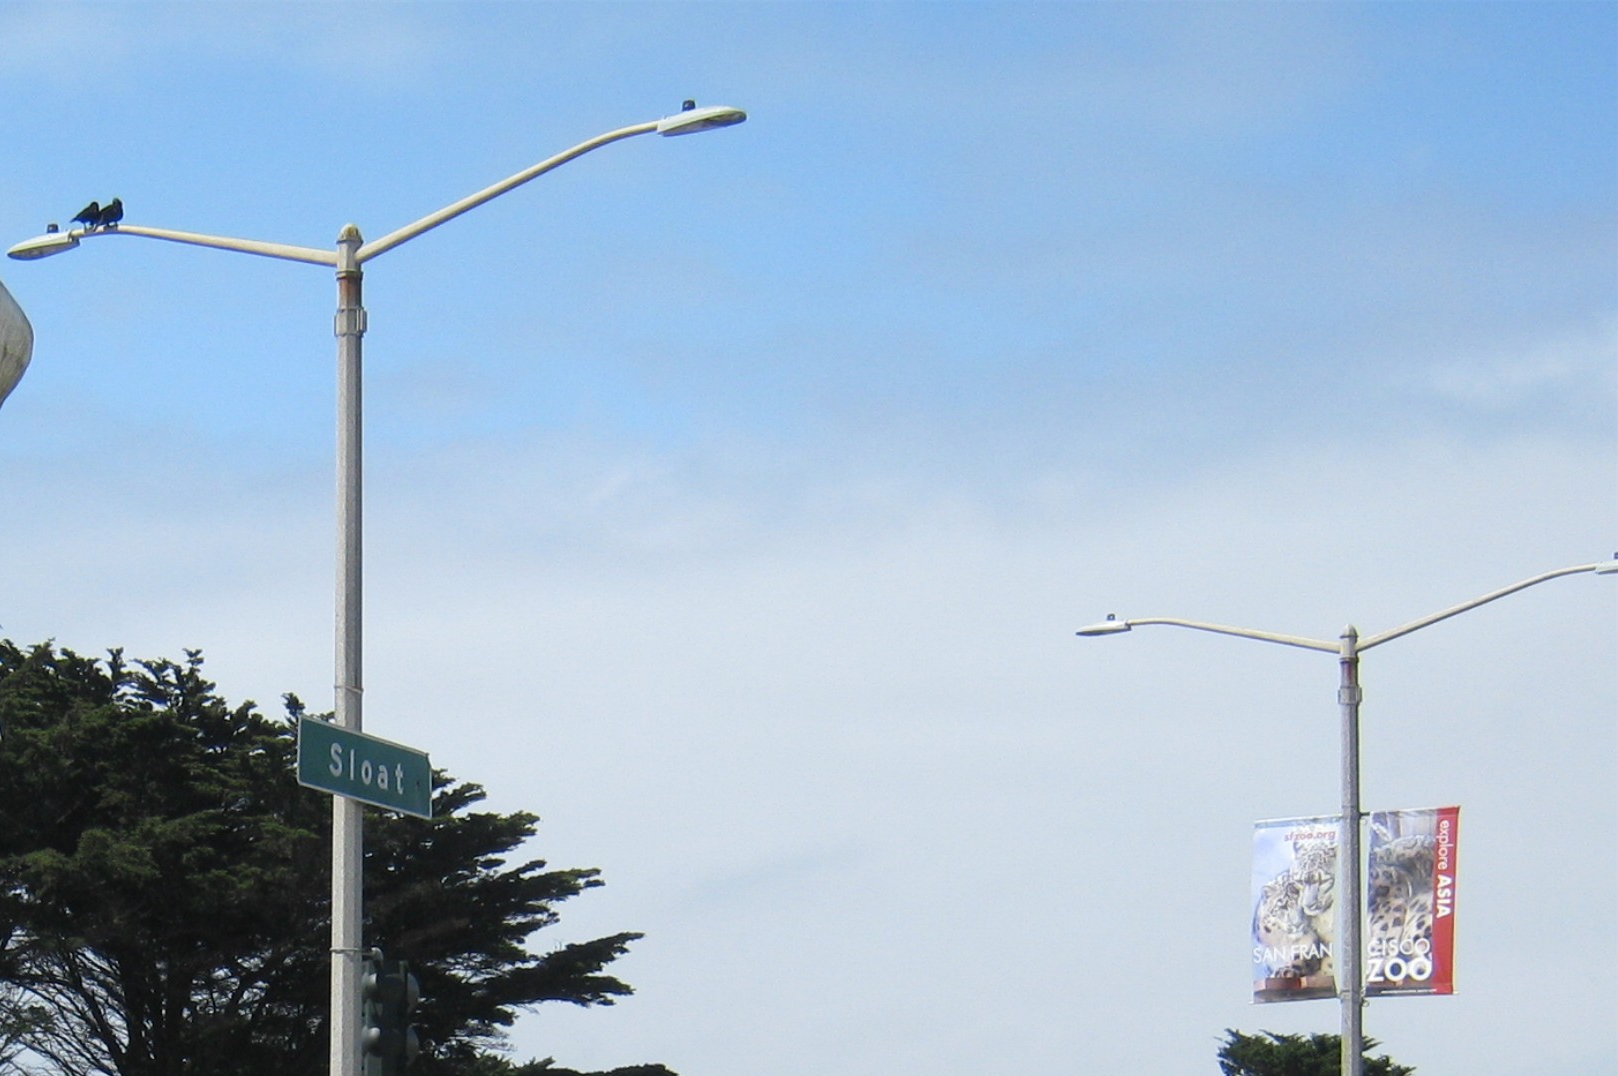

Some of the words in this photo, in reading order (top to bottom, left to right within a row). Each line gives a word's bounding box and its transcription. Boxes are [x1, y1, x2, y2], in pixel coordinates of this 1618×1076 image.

[329, 742, 404, 795] Sloat
[1436, 819, 1455, 871] explore
[1436, 874, 1453, 919] ASIA
[1253, 946, 1286, 964] SAN
[1366, 956, 1433, 982] ZOO
